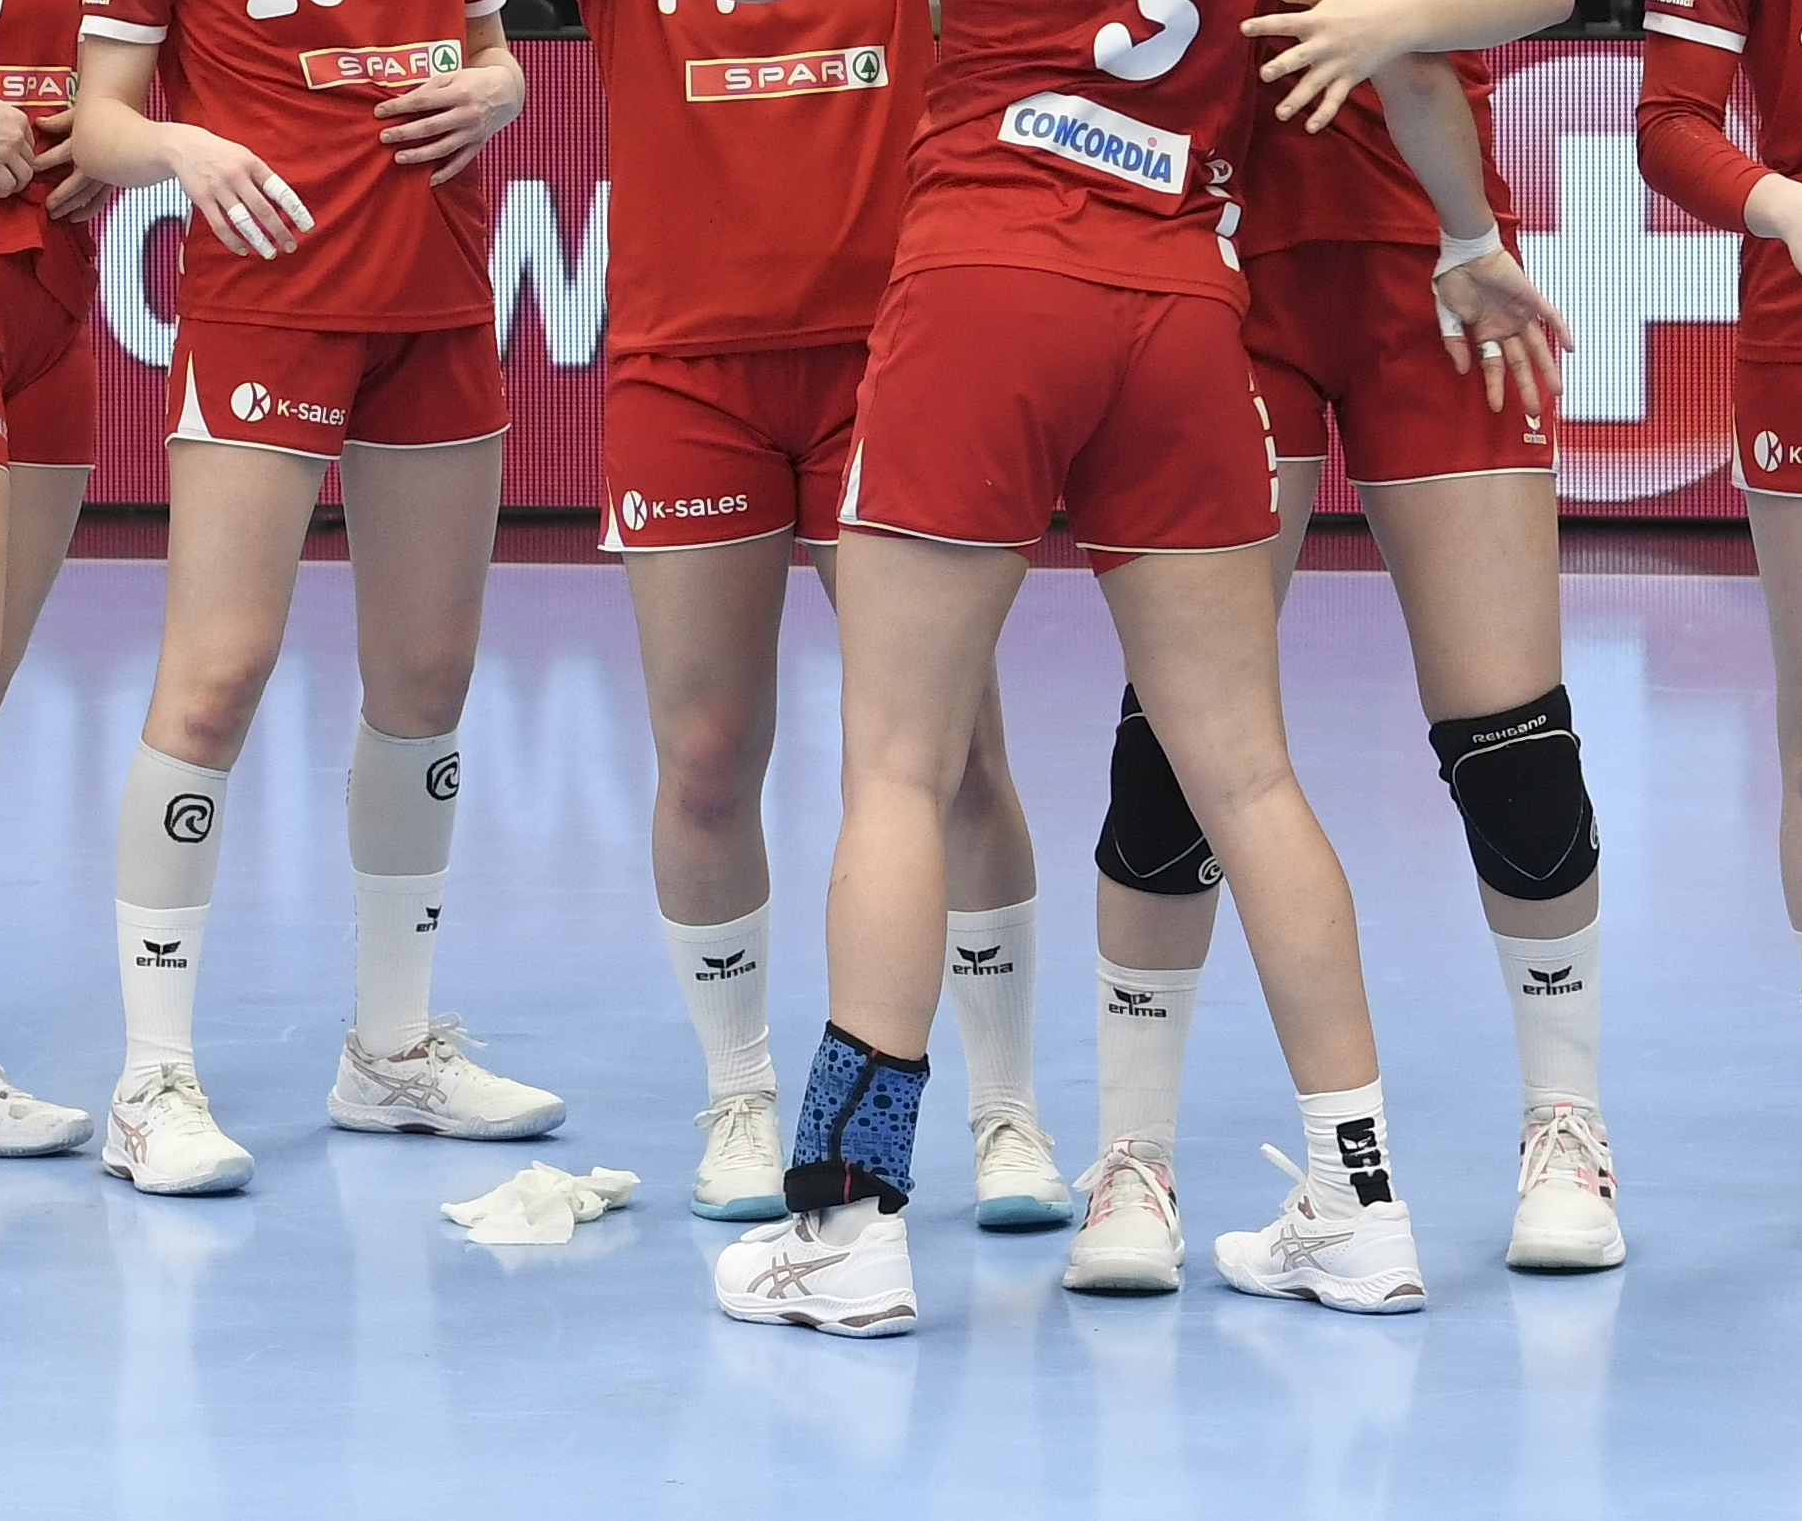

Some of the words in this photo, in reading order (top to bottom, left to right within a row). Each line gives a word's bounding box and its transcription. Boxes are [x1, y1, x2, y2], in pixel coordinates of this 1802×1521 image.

[335, 53, 428, 79] SPAR
[723, 59, 845, 91] SPAR
[1013, 106, 1171, 184] CONCORDIA
[135, 954, 188, 969] erima
[694, 960, 757, 981] erima
[951, 961, 1014, 976] erima
[1521, 979, 1584, 996] erima
[1107, 1001, 1167, 1019] erima
